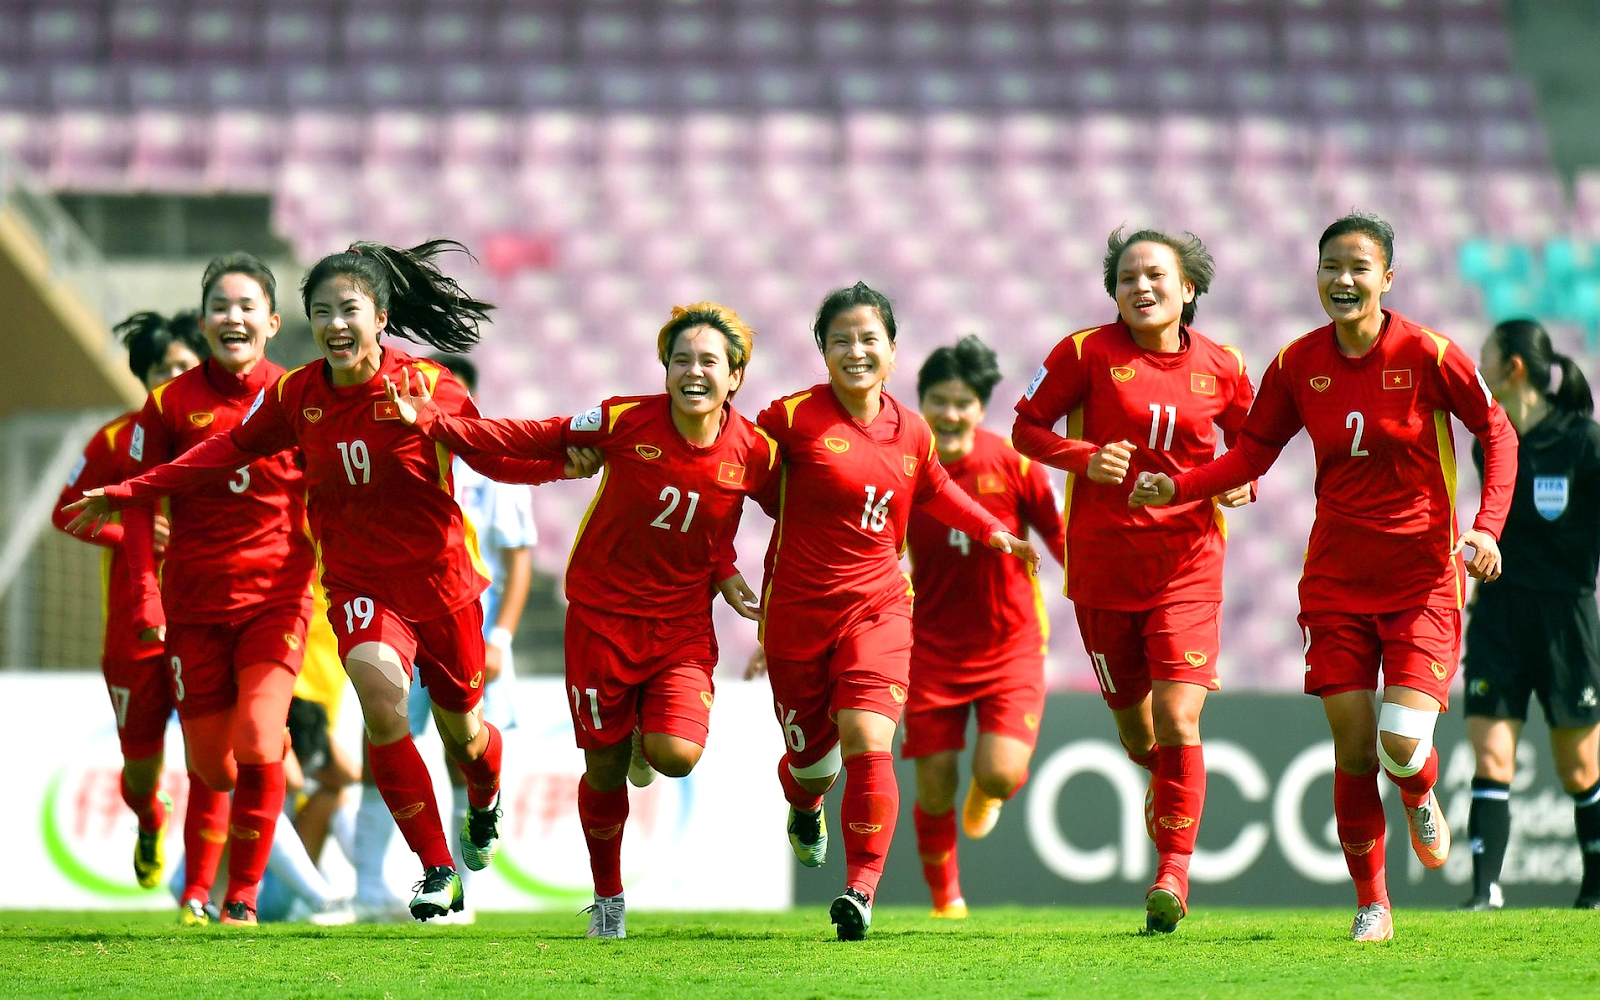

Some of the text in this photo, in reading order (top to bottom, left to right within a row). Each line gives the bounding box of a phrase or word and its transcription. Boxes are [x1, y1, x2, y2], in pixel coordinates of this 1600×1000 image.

[1148, 404, 1177, 452] 11
[1345, 411, 1369, 457] 2
[337, 439, 371, 486] 19
[650, 485, 700, 533] 21
[860, 485, 895, 533] 16
[949, 527, 970, 556] 4
[343, 596, 375, 635] 19
[170, 655, 185, 701] 3
[777, 701, 806, 753] 16
